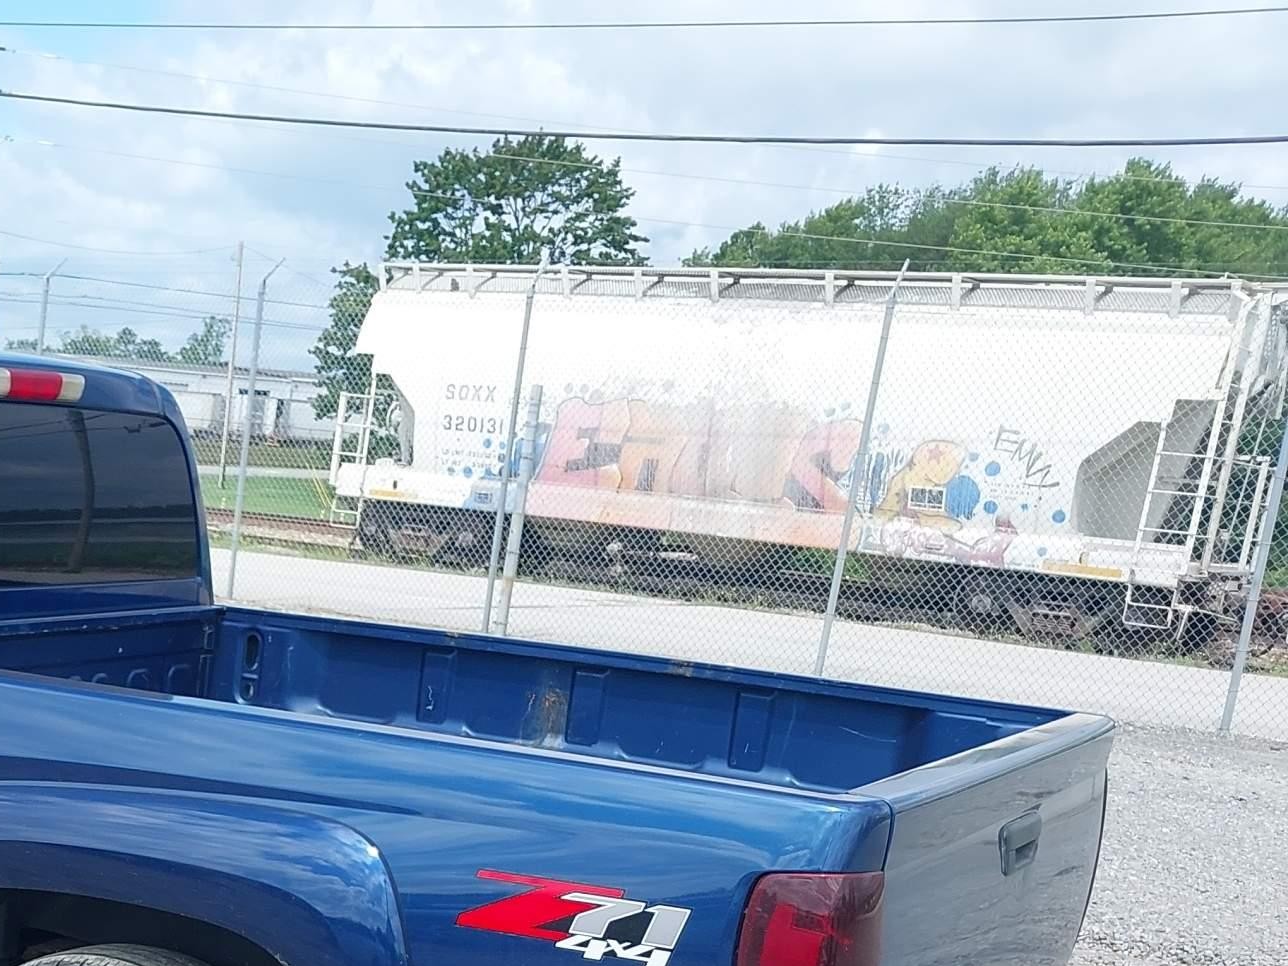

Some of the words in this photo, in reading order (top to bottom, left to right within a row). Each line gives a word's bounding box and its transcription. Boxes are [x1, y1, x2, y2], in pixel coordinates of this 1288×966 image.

[445, 383, 497, 403] SOXX
[443, 414, 503, 435] 320131
[455, 868, 694, 950] Z71
